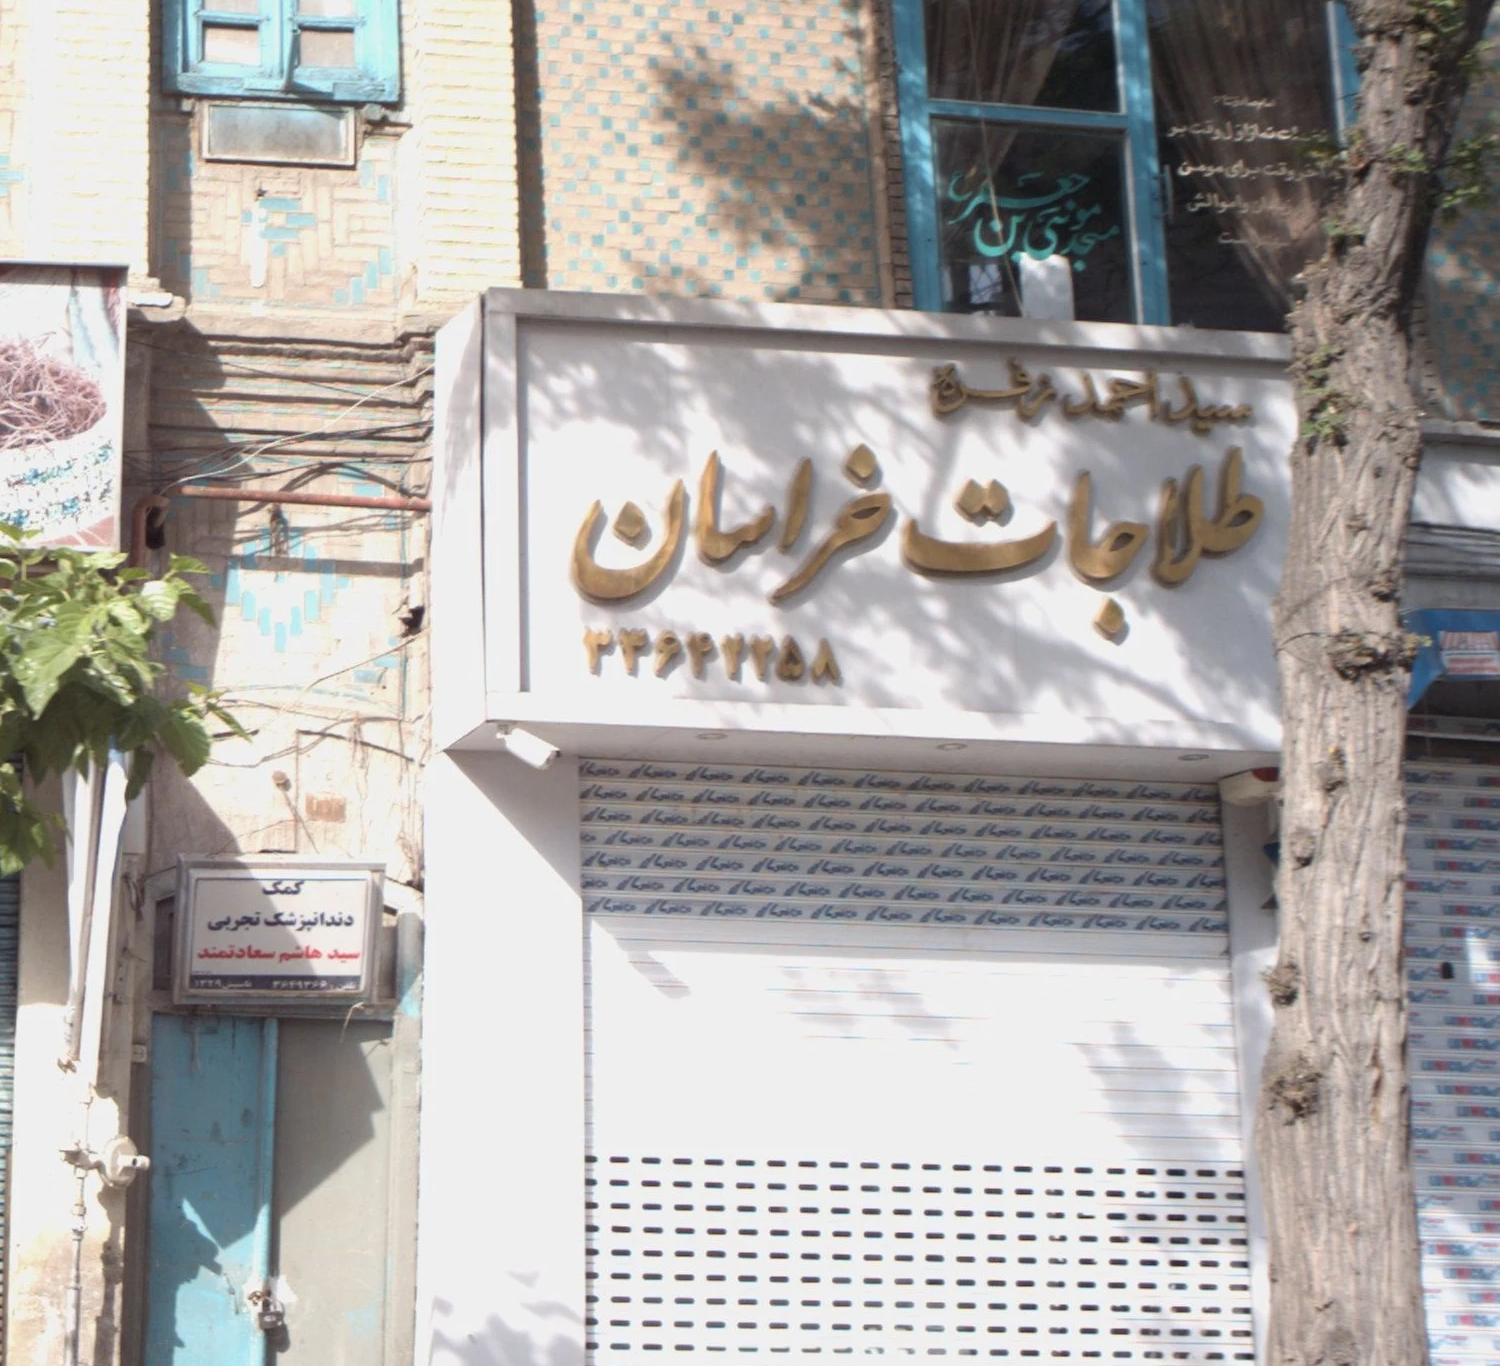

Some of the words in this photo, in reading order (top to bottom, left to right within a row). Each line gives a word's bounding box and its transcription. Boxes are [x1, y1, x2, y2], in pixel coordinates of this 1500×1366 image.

[1064, 368, 1159, 421] احمد
[1165, 374, 1254, 436] سید
[571, 442, 894, 604] خراسان
[900, 446, 1266, 642] طلاجات
[262, 879, 305, 896] کمک
[208, 911, 261, 932] تجربی
[264, 911, 354, 933] دندانپزشک
[196, 944, 276, 960] سعادتمند
[279, 944, 323, 963] هاشم
[327, 946, 361, 964] سید
